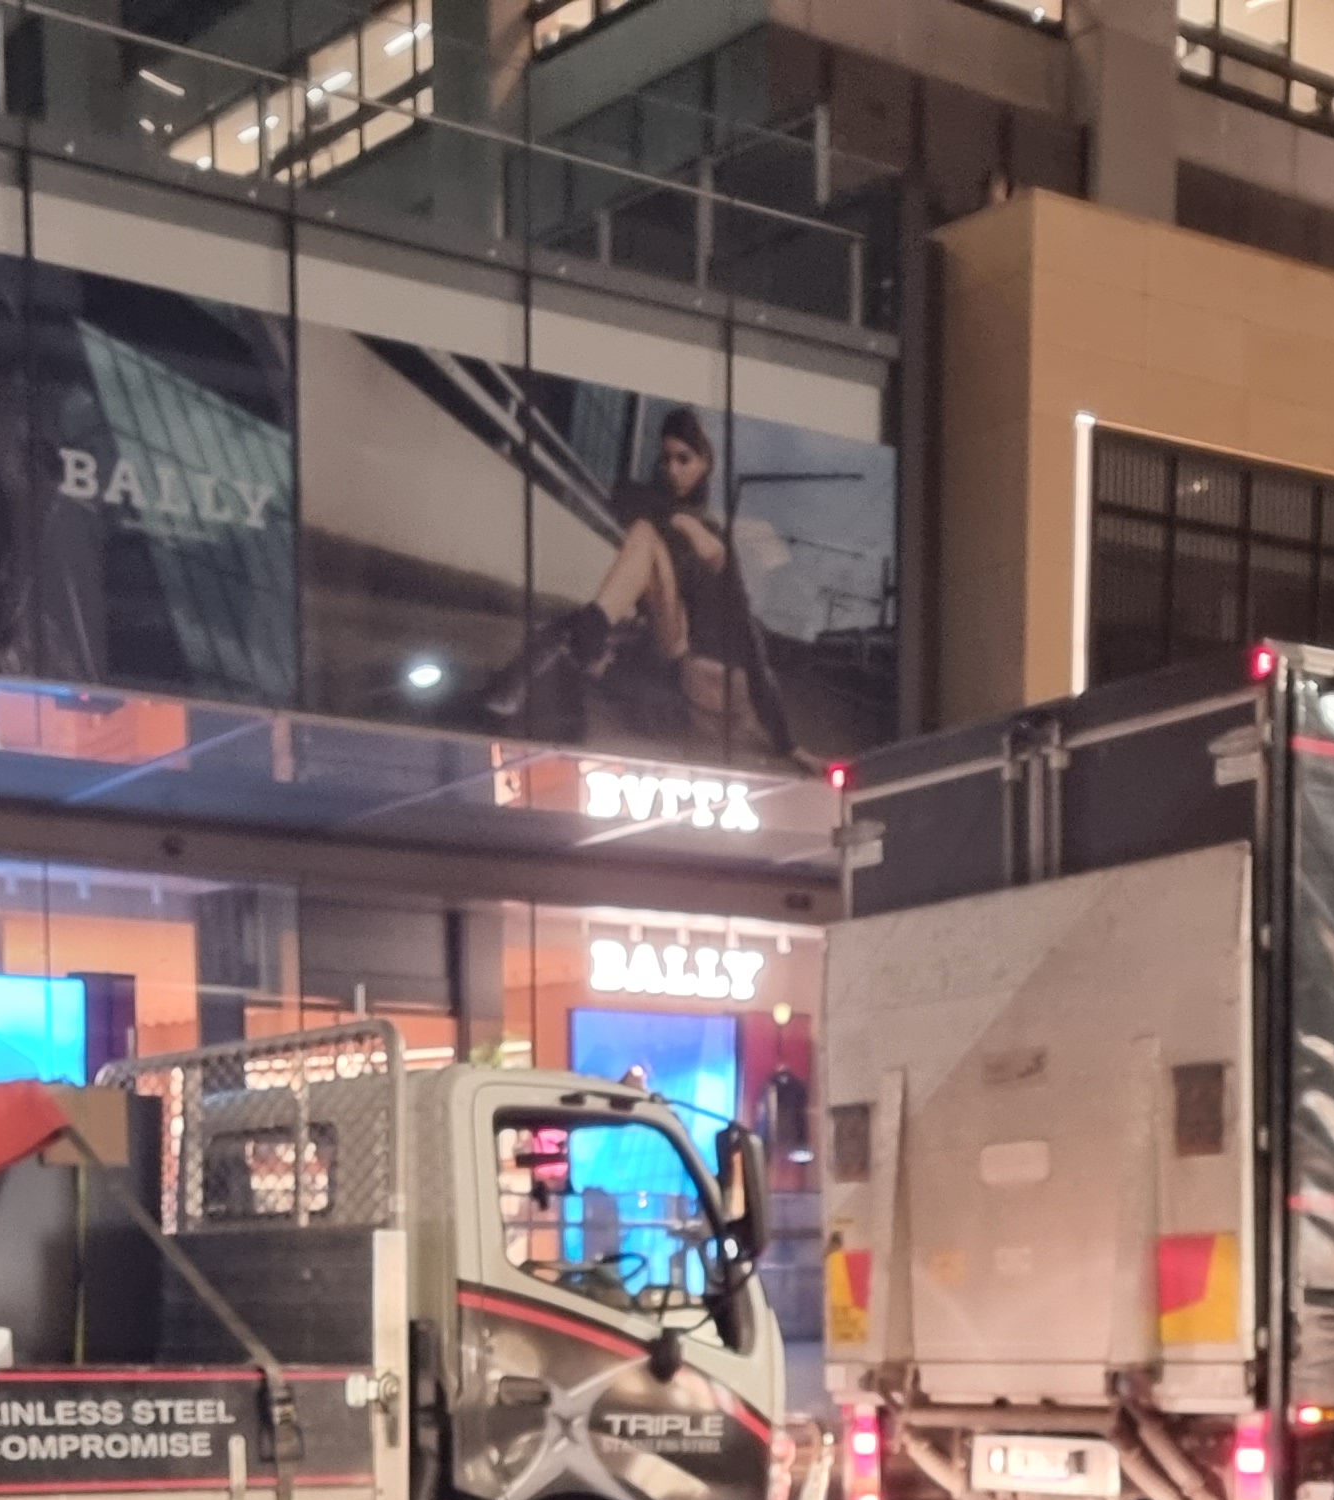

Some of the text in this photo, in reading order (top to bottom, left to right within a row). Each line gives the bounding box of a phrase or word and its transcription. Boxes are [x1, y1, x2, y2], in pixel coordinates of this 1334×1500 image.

[58, 447, 275, 530] BALLY
[590, 938, 764, 1001] BALLY
[132, 1399, 235, 1425] STEEL
[604, 1413, 725, 1437] TRIPLE
